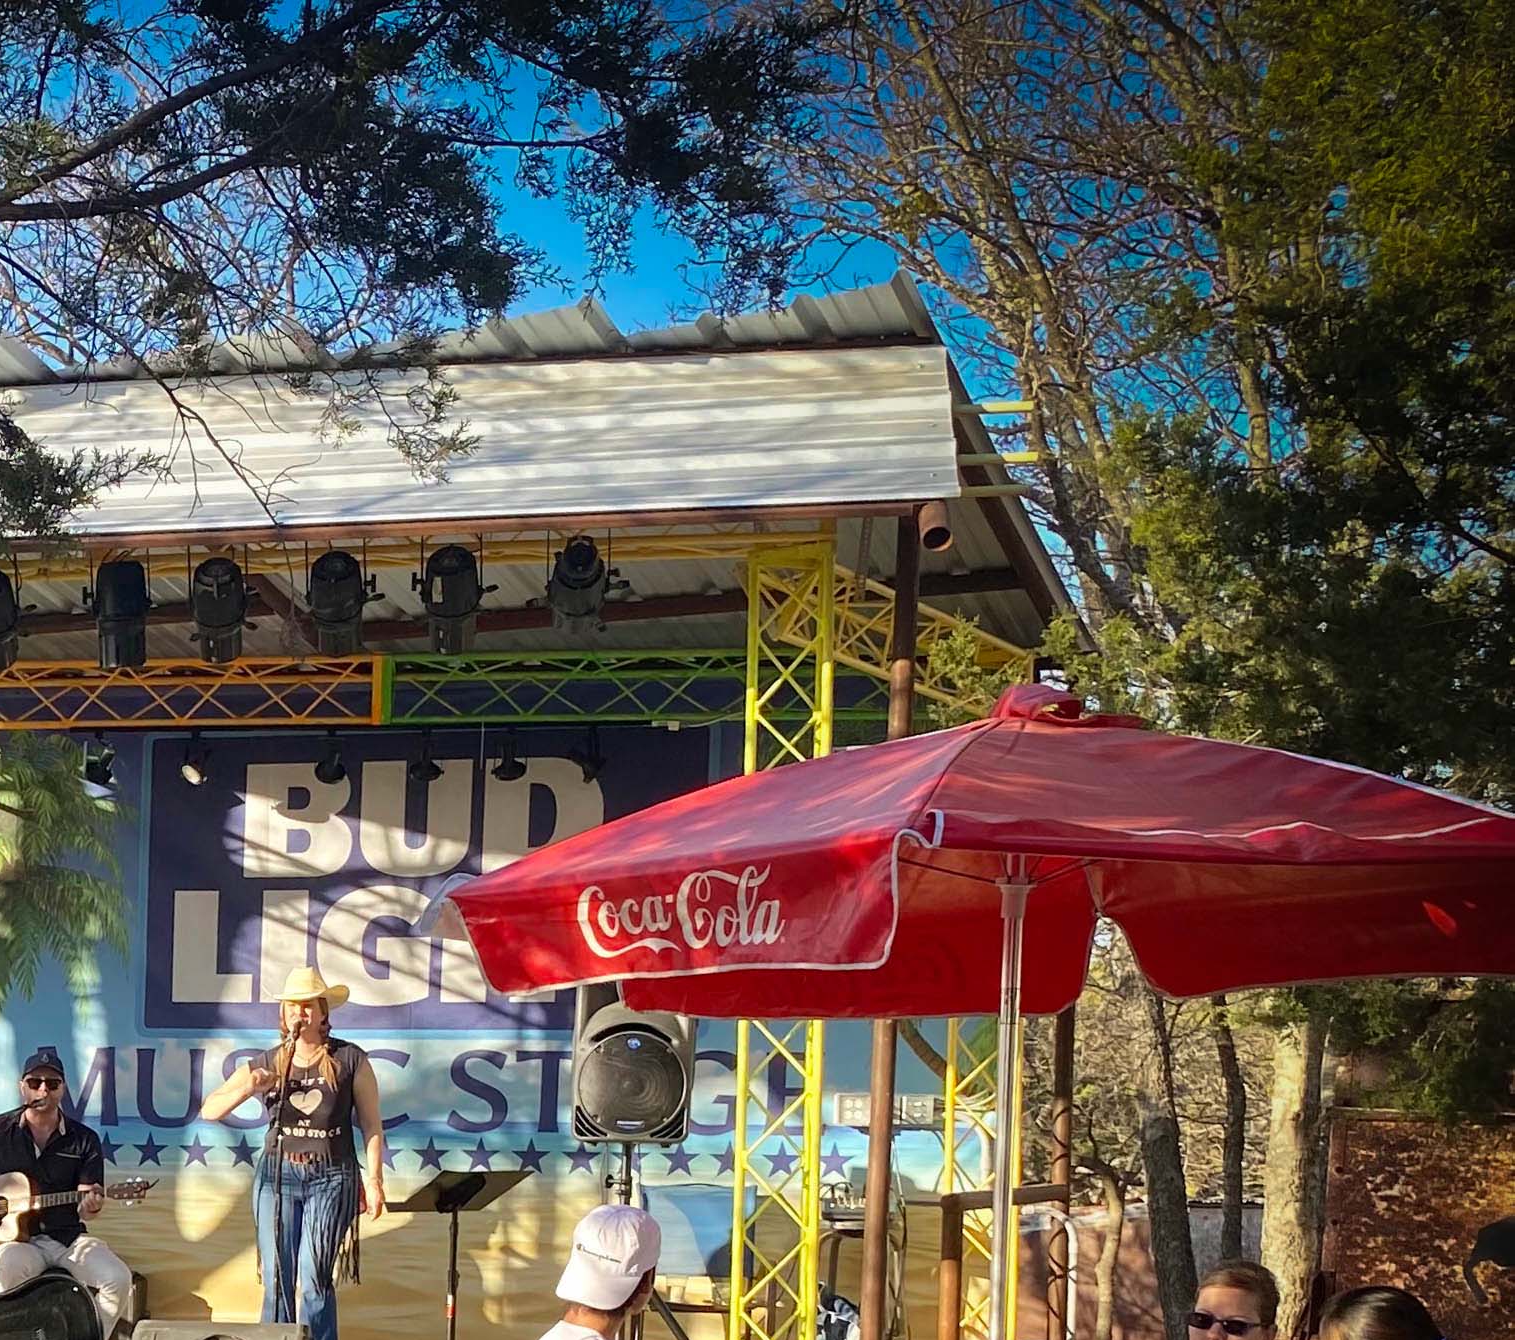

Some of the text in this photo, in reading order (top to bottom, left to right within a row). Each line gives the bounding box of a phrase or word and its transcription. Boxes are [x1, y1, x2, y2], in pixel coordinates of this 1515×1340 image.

[243, 757, 605, 879] BUD
[172, 886, 556, 1006] LIG
[577, 863, 785, 958] Coca-Cola
[37, 1046, 827, 1135] MUSC STGE
[282, 1126, 342, 1139] OODSTOCK
